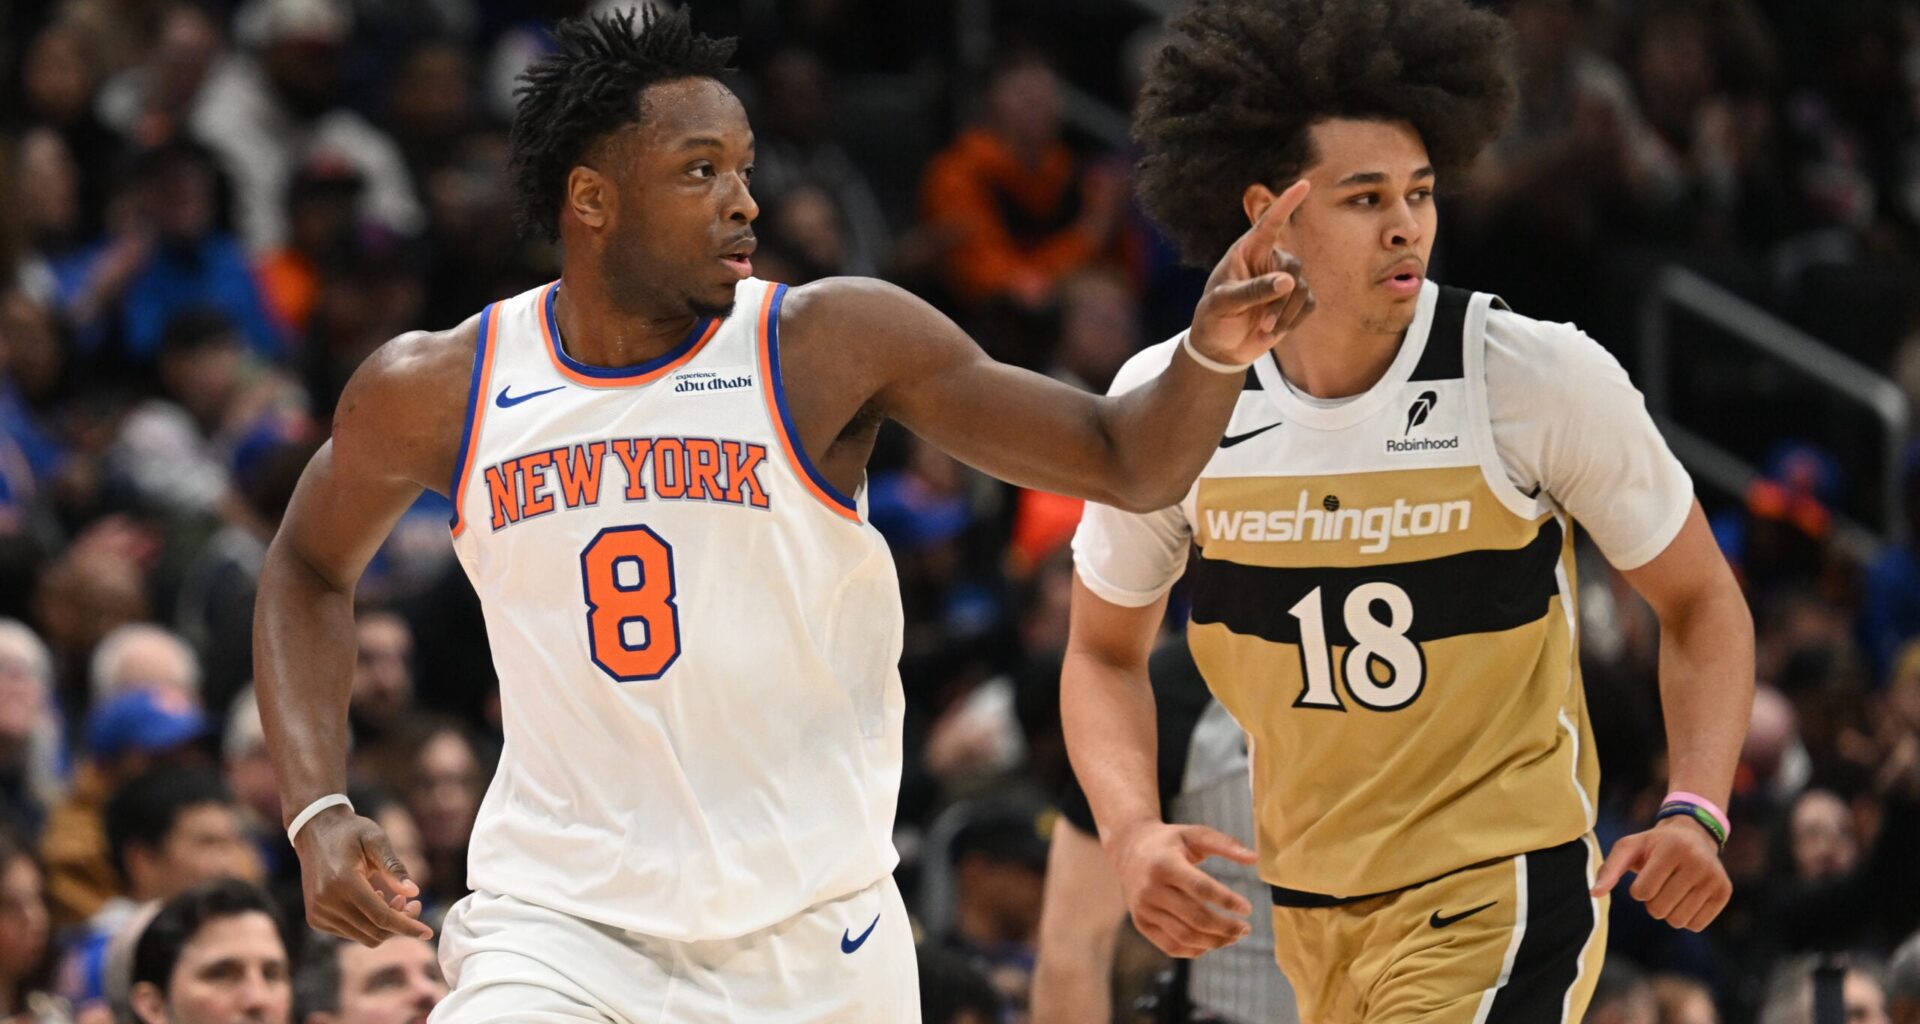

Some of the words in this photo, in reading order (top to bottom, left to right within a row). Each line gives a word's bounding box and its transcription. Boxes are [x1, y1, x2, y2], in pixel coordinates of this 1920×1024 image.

[675, 371, 717, 380] experience
[675, 380, 705, 393] abu
[707, 375, 752, 390] dhabi
[1386, 435, 1458, 452] Robinhood
[484, 441, 606, 532] NEW
[611, 437, 770, 511] YORK
[1205, 489, 1472, 554] washington
[580, 524, 682, 683] 8
[1287, 578, 1427, 713] 18
